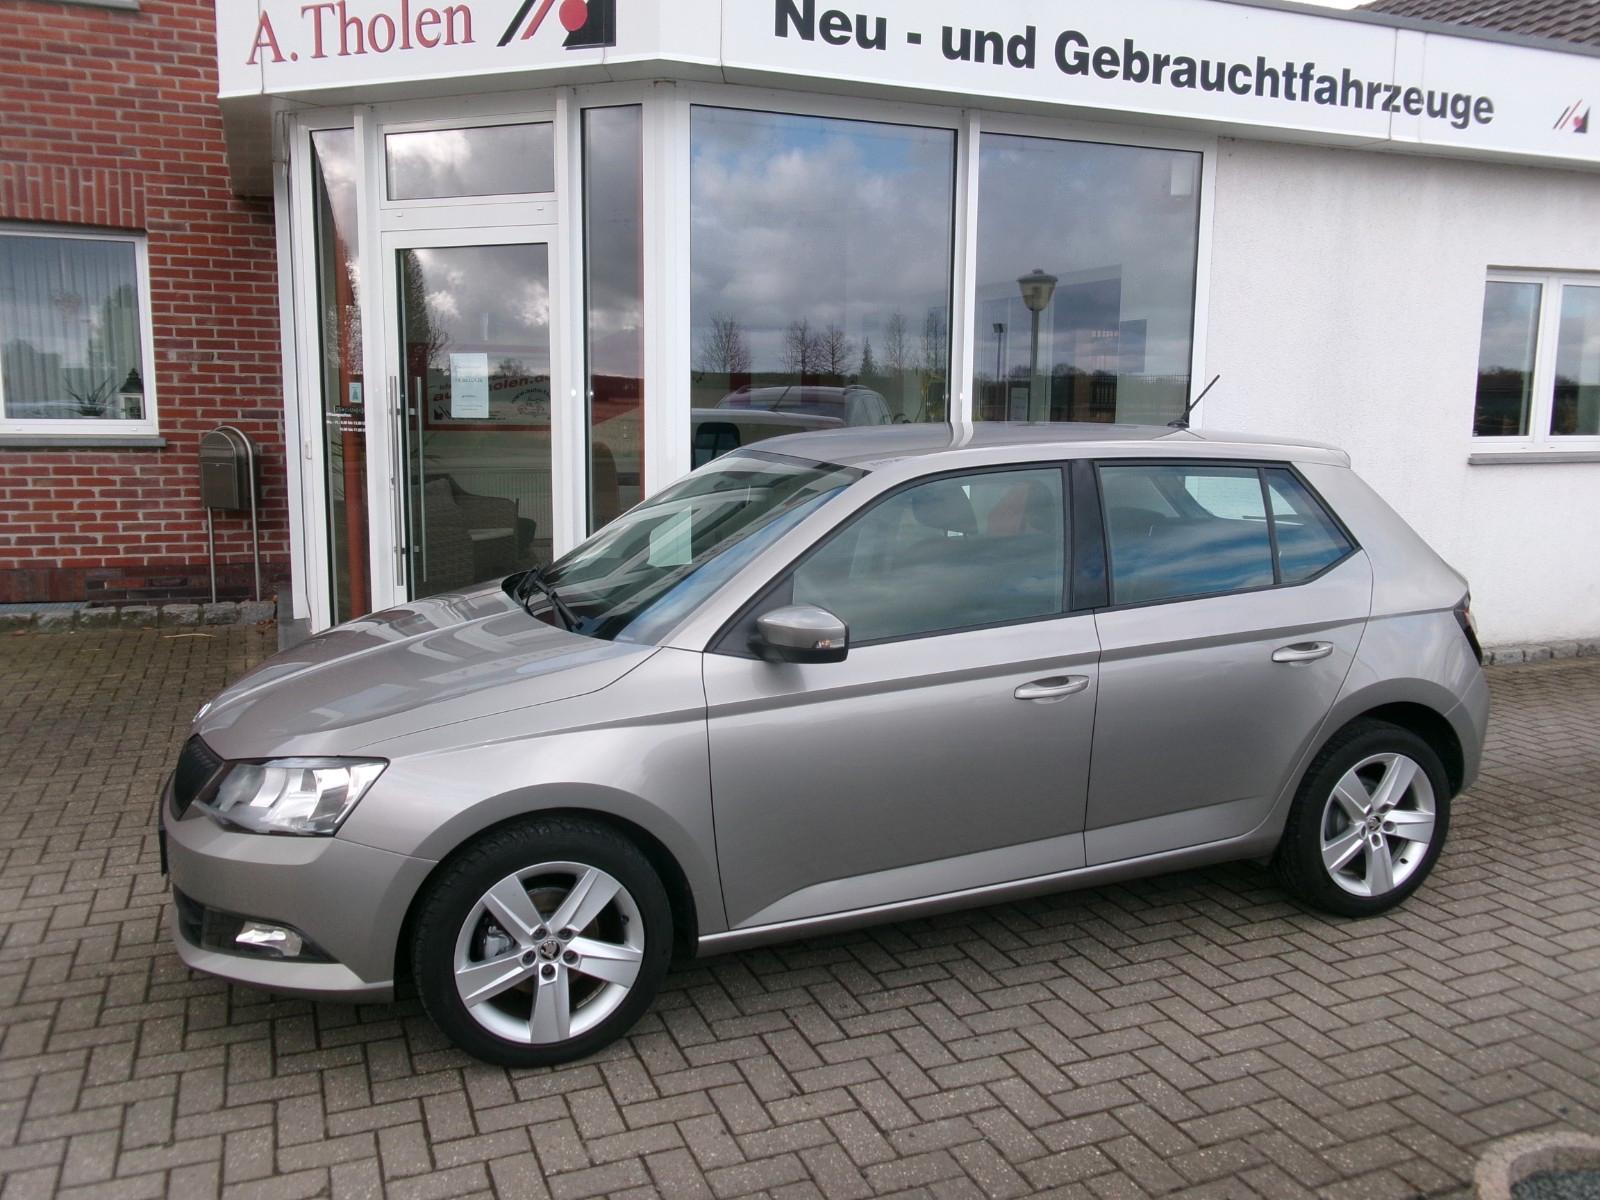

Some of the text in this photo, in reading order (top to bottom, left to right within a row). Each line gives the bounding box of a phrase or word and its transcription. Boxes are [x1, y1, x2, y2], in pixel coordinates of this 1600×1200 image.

[774, 0, 888, 51] Neu
[941, 25, 1037, 69] und
[1054, 30, 1495, 130] Gebrauchtfahrzeuge
